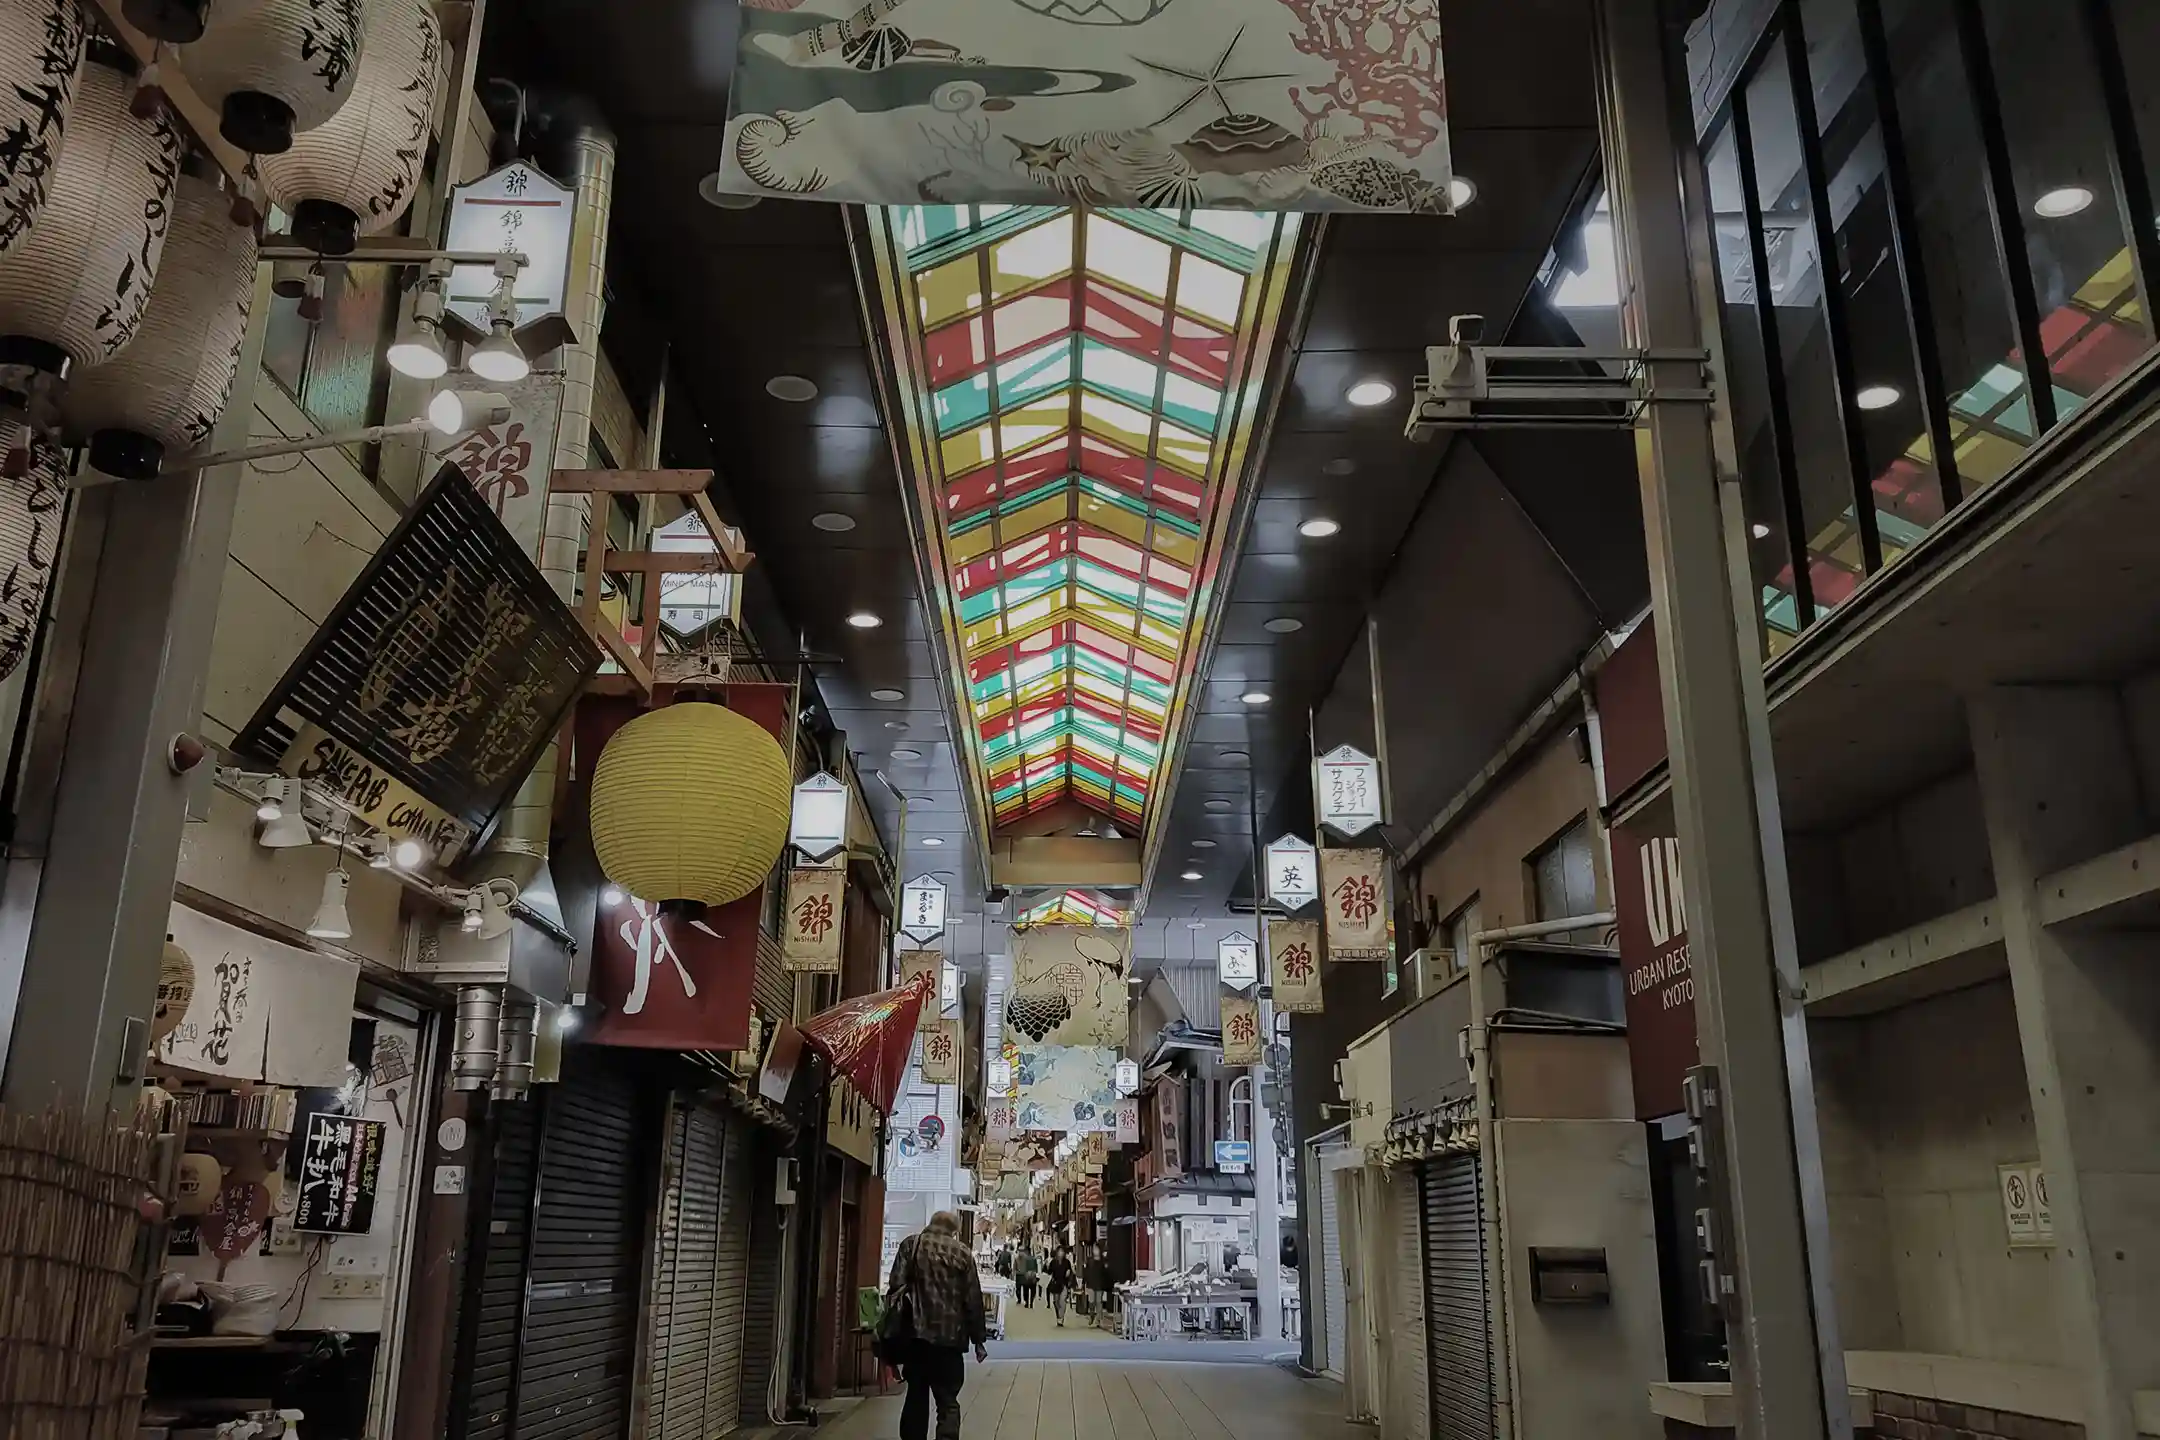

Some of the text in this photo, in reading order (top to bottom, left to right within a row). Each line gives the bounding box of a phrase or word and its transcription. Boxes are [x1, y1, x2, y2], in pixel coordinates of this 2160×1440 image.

[501, 168, 528, 196] 錦
[437, 422, 532, 516] 錦
[345, 765, 389, 813] PUB
[1331, 768, 1345, 812] サカグチ
[1354, 768, 1367, 808] フラワー
[1280, 866, 1304, 889] 英
[792, 893, 834, 944] 錦
[1332, 874, 1378, 930] 錦
[1276, 942, 1315, 988] 錦
[1630, 959, 1665, 996] URBAN
[1662, 978, 1695, 1011] KYOTO
[1226, 1013, 1255, 1046] 錦
[926, 1035, 951, 1068] 錦
[990, 1107, 1008, 1128] 錦
[1119, 1108, 1136, 1128] 錦
